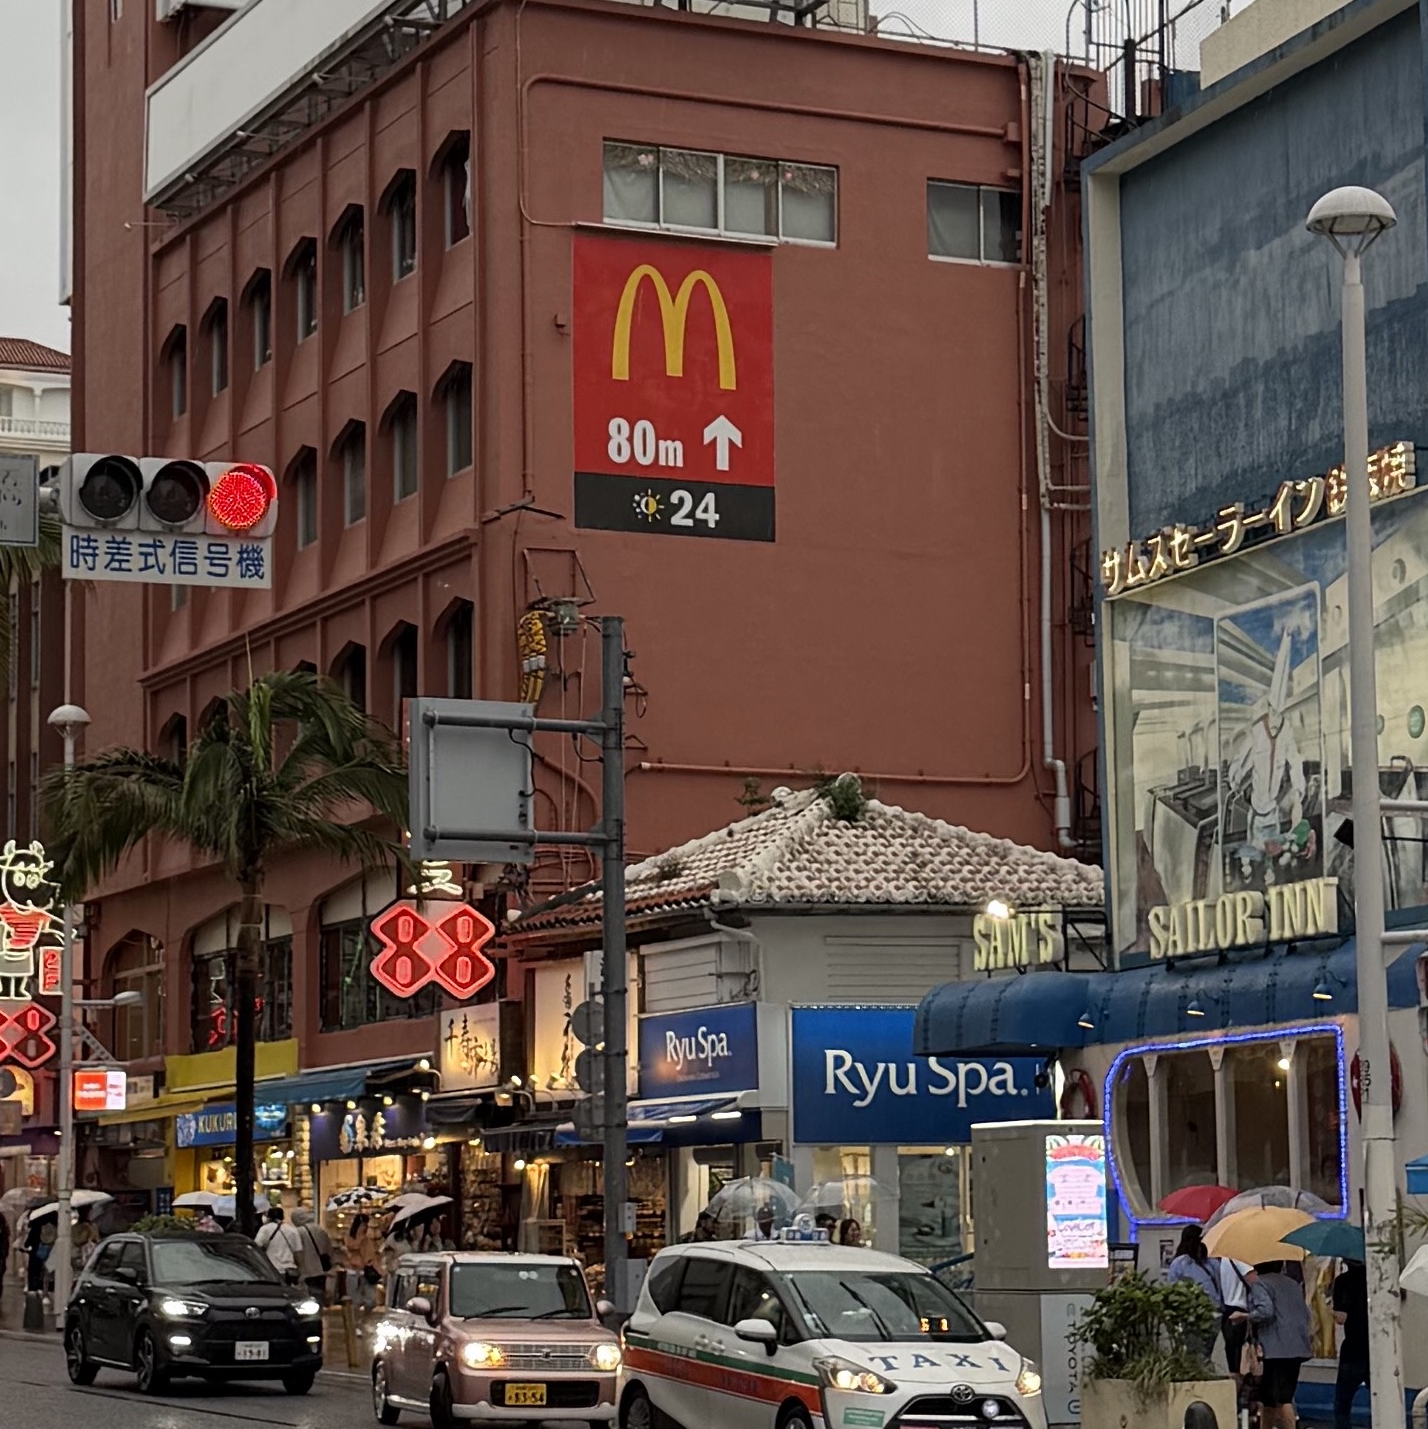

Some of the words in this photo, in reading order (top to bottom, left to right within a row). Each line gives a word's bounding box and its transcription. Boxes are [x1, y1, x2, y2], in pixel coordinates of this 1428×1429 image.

[607, 417, 684, 468] 80m
[670, 489, 720, 528] 24
[71, 534, 265, 580] 時差式信号機
[974, 905, 1059, 970] SAM'S
[1149, 890, 1264, 960] SAILOR
[1269, 876, 1338, 941] INN
[666, 1031, 696, 1070] Ryu
[824, 1049, 918, 1107] Ryu
[869, 1351, 1010, 1373] TAXI
